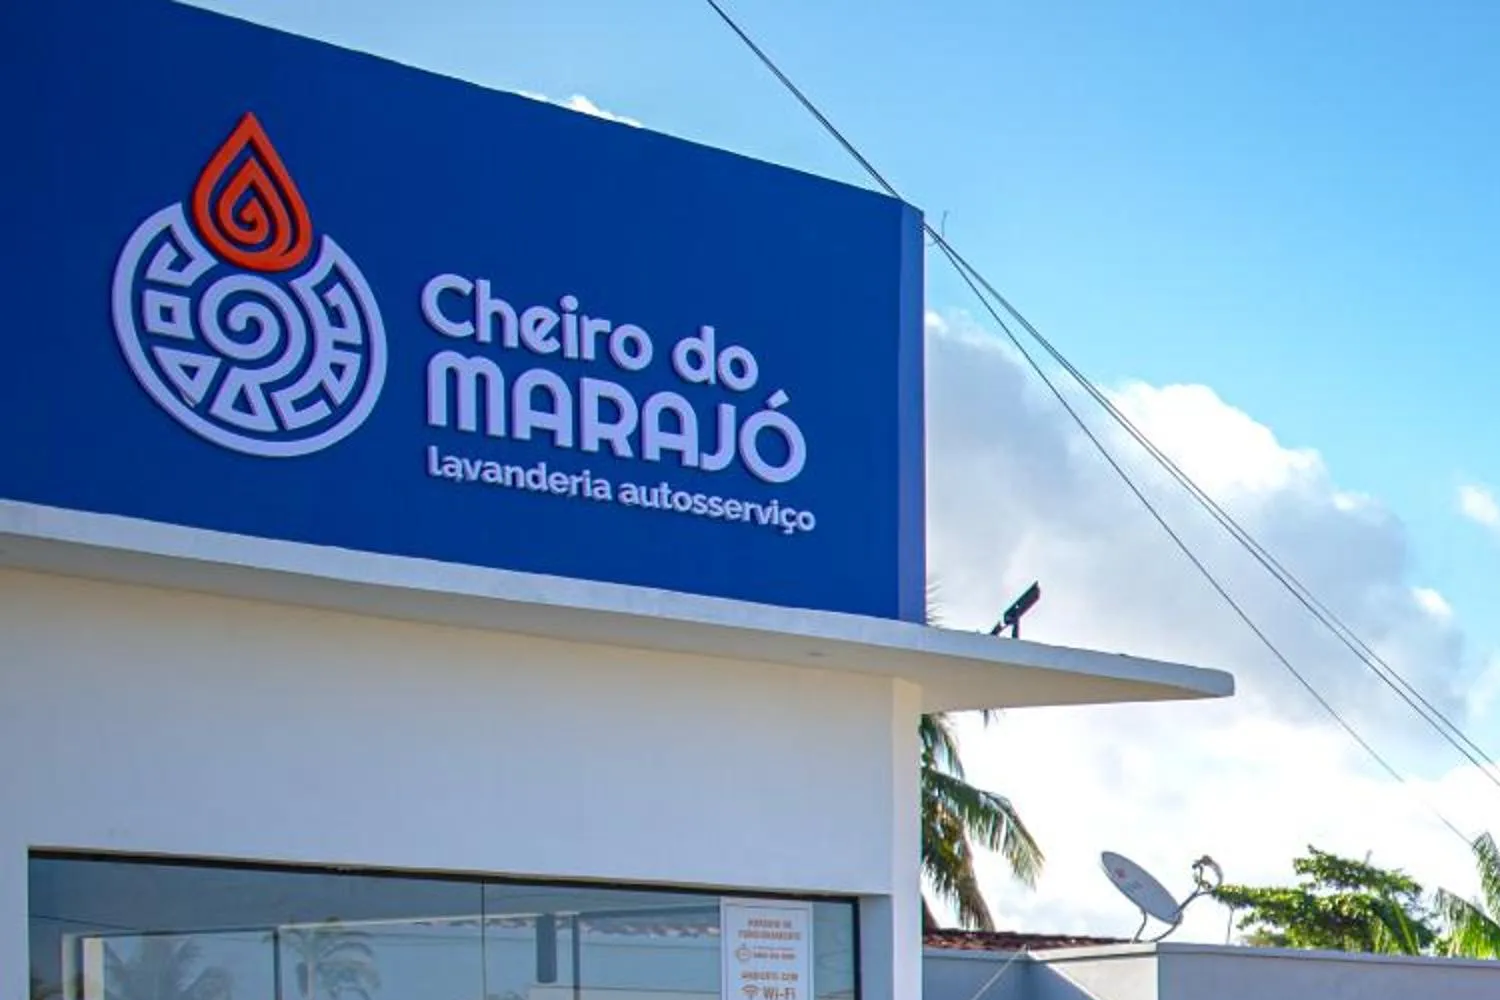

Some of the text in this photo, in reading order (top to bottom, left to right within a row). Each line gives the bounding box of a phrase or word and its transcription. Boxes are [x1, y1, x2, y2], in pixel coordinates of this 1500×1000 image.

[421, 272, 760, 393] Cheiro do
[426, 350, 808, 485] MARAJÓ
[427, 445, 817, 535] lavanderia autosserviço
[762, 986, 796, 1000] Wi-Fi
